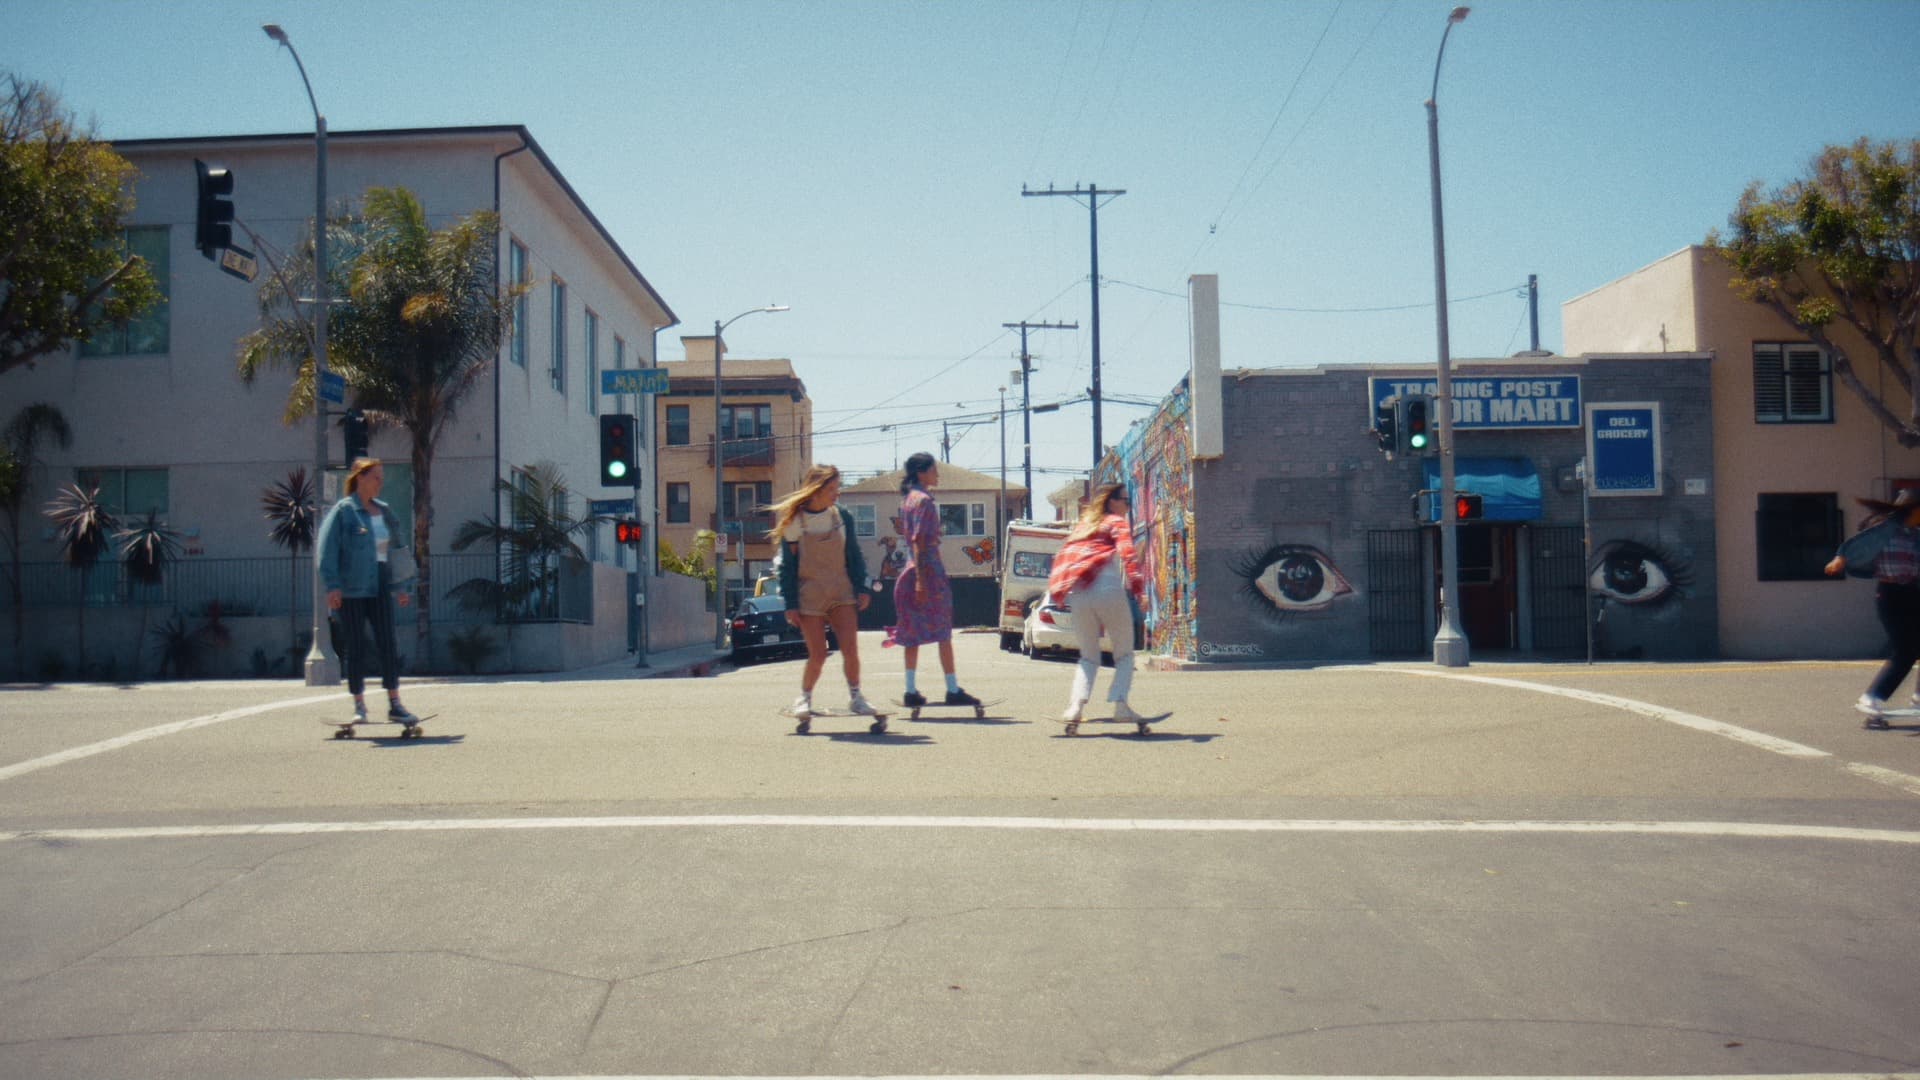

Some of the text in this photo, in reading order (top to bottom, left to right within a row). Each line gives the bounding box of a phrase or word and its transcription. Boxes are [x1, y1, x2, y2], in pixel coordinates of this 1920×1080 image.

[1500, 381, 1562, 398] POST
[1490, 398, 1574, 422] MART
[1609, 417, 1635, 427] DELI
[1597, 429, 1649, 439] GROCERY
